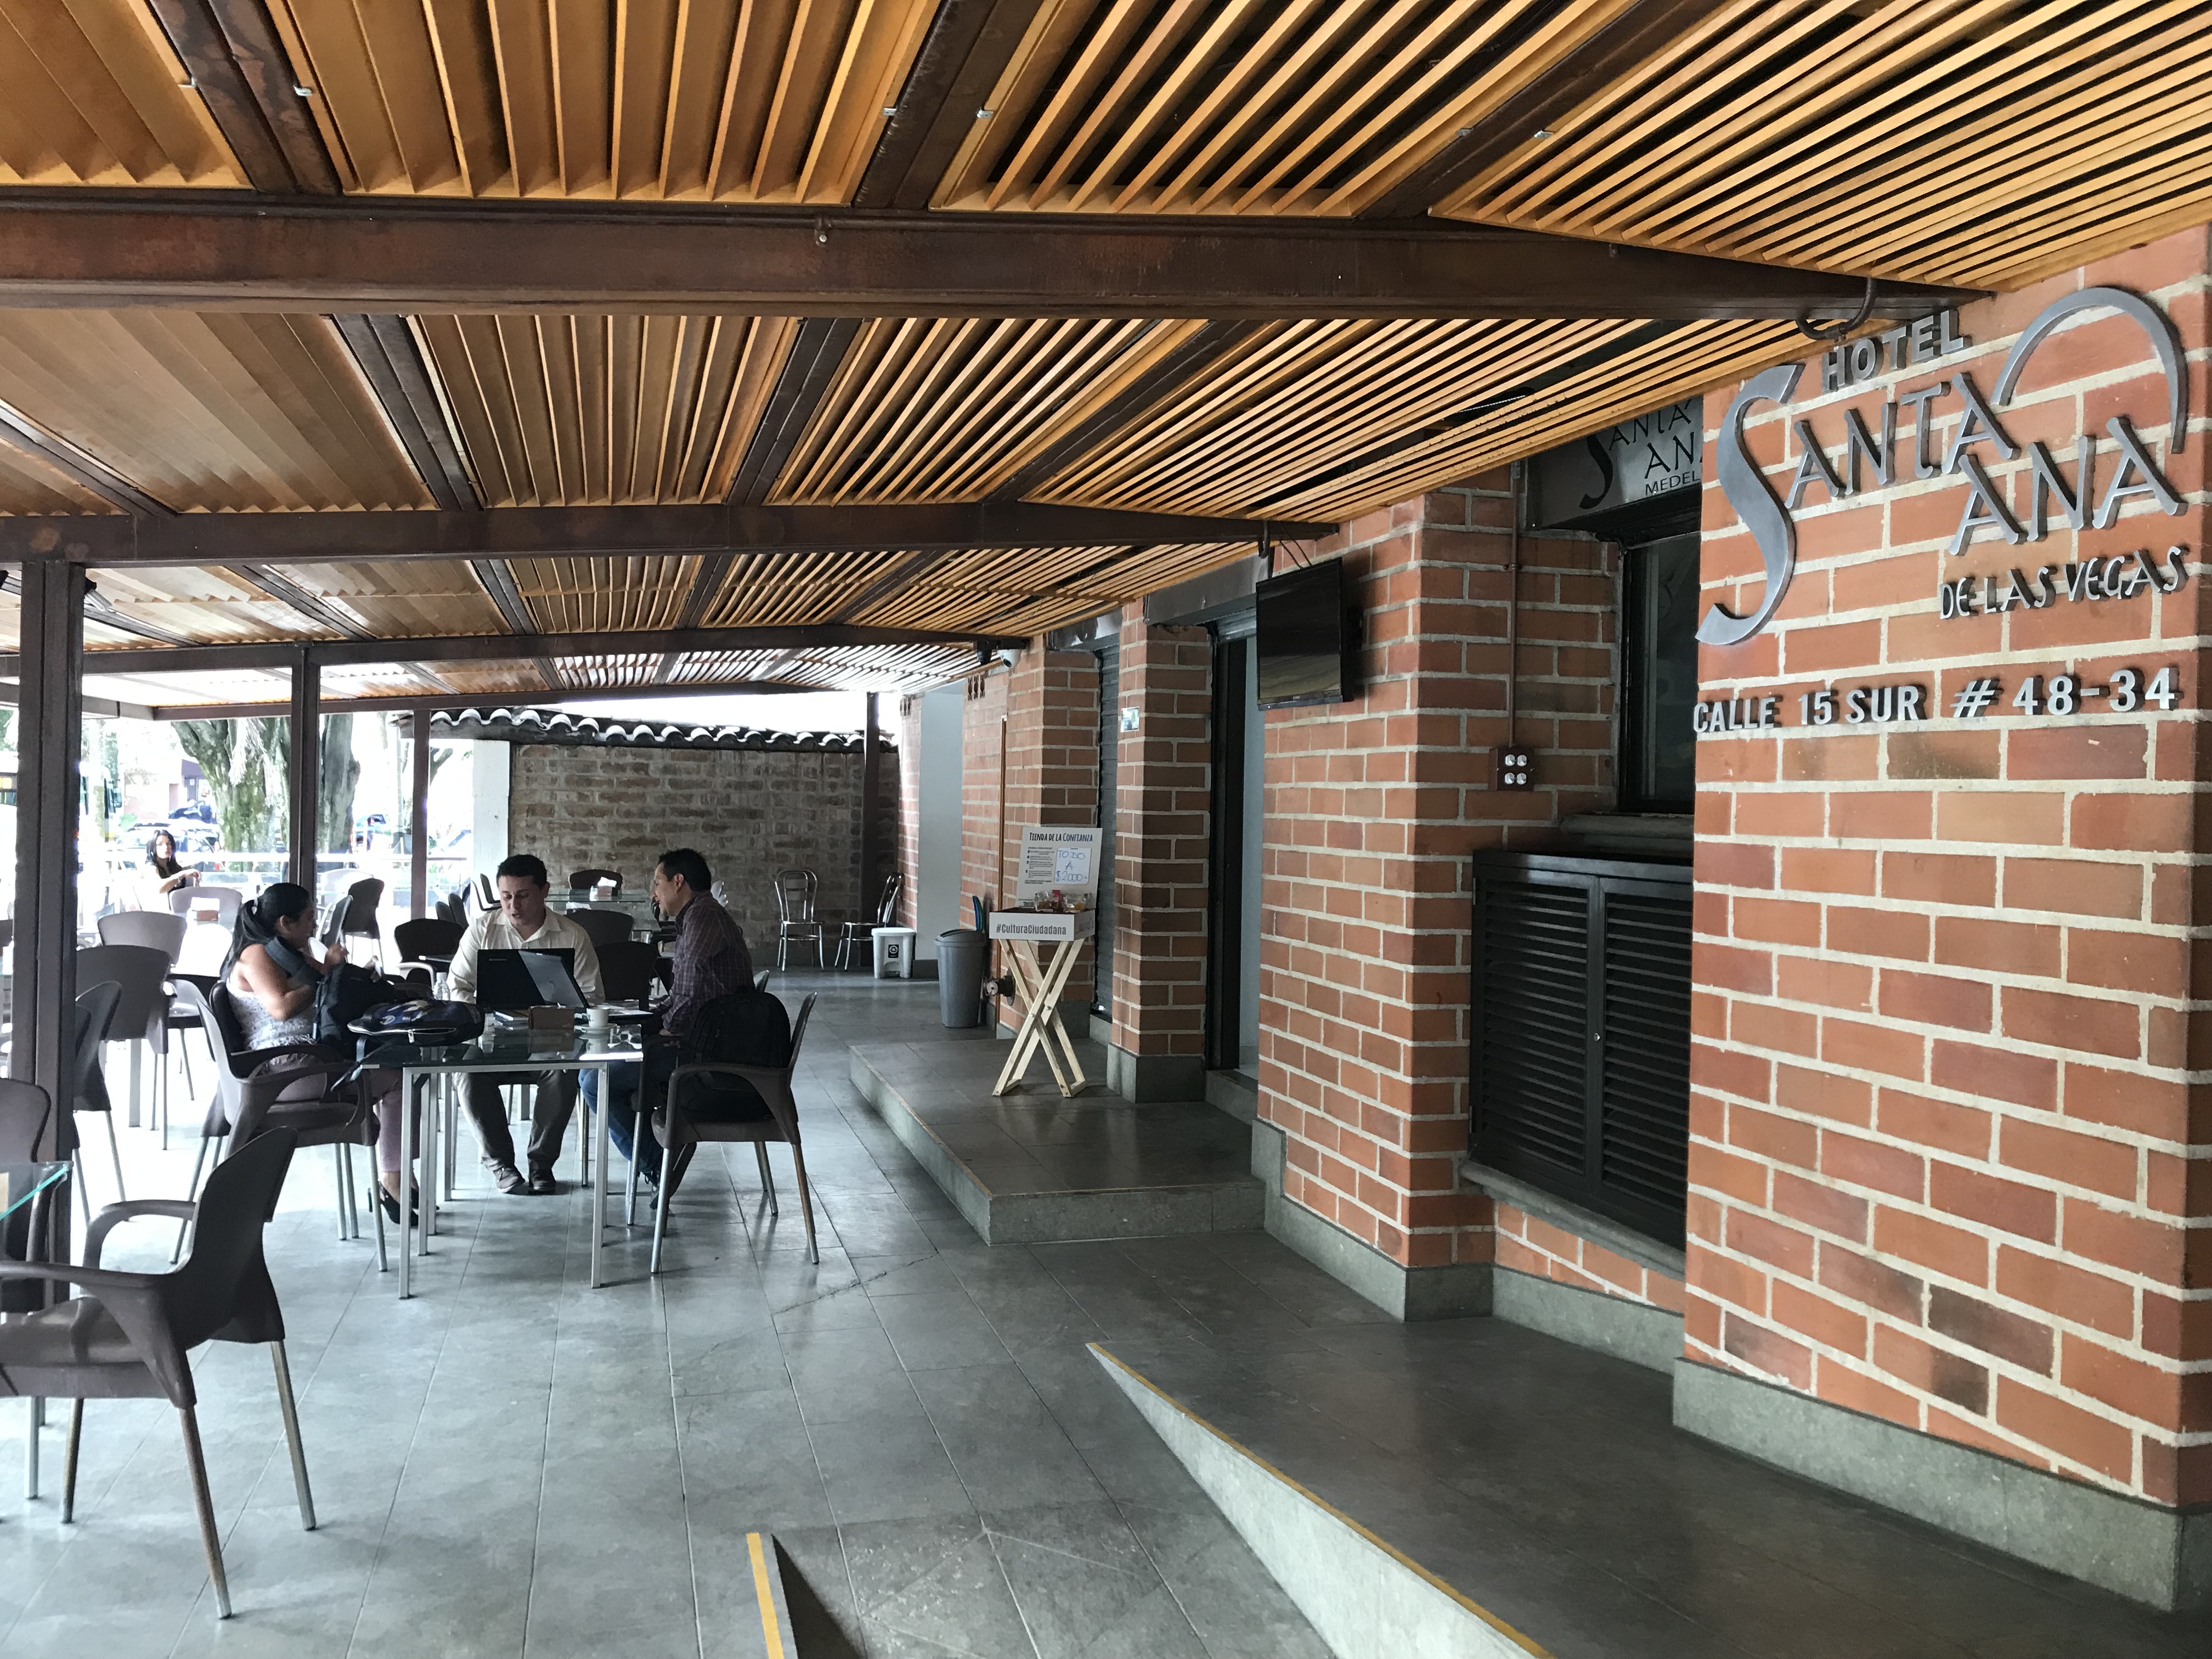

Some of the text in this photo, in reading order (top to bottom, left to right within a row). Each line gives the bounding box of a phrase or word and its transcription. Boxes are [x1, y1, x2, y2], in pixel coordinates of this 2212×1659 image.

[1822, 309, 1971, 393] HOTEL
[1645, 431, 1702, 479] AN
[1949, 416, 2188, 556] ANA
[1695, 364, 2021, 646] SANTA
[1939, 544, 2190, 620] DE LAS VEGAS
[1693, 665, 2185, 733] CALLE 15 SUR # 48-34
[1029, 832, 1047, 841] TIENDA
[1063, 833, 1093, 842] CONFIANZA
[1065, 861, 1074, 871] A
[996, 924, 1066, 935] #CulturaCiudadana
